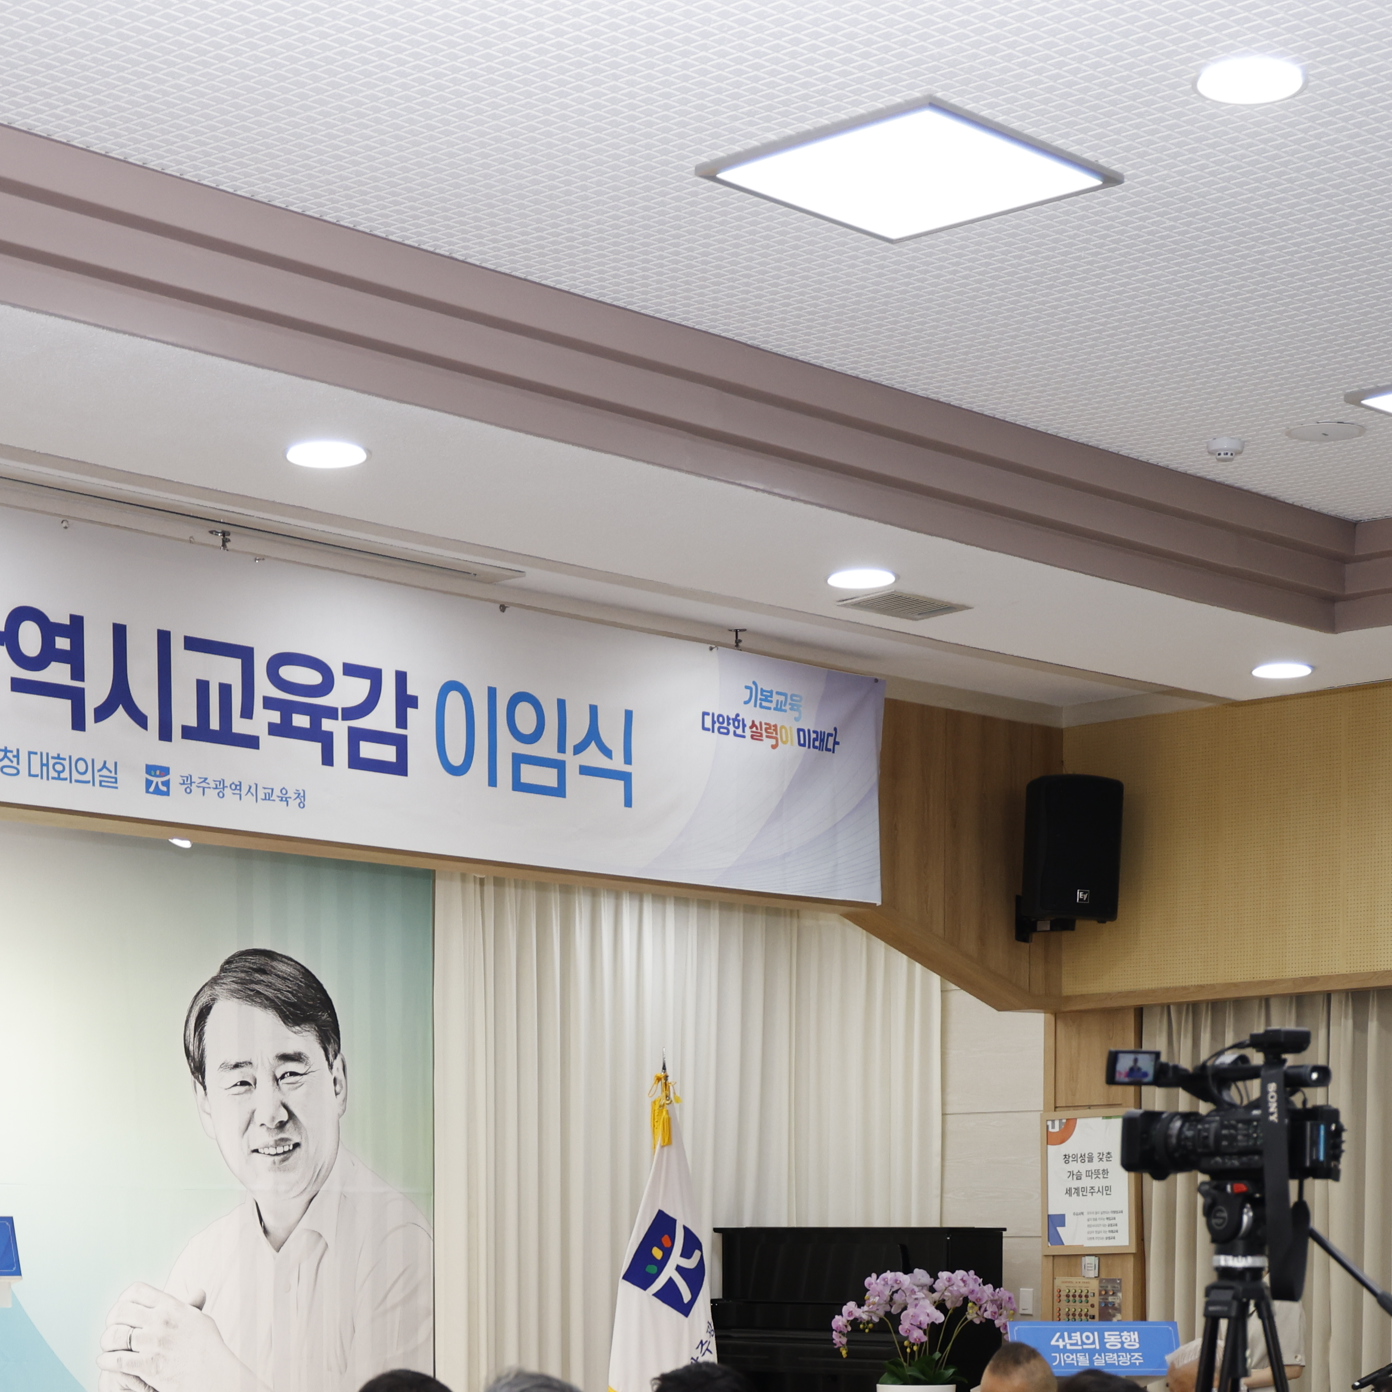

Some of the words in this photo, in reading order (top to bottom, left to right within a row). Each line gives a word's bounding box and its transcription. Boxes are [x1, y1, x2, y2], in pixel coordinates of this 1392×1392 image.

[743, 680, 803, 722] 기본교육
[434, 677, 635, 809] 이임식
[701, 711, 747, 739] 다양한
[749, 720, 794, 750] 실력이
[797, 726, 840, 754] 미래다
[27, 751, 119, 790] 대회의실
[178, 773, 307, 809] 광주광역시교육청
[1267, 1082, 1278, 1123] SONY
[1063, 1152, 1094, 1164] 창의성을
[1097, 1151, 1113, 1163] 갖춘
[1067, 1170, 1083, 1181] 가슴
[1085, 1168, 1109, 1180] 따뜻한
[1064, 1185, 1112, 1197] 세계민주시민
[1050, 1331, 1100, 1349] 4년의
[1104, 1331, 1140, 1349] 동행
[1051, 1353, 1090, 1366] 기억될
[1093, 1352, 1144, 1366] 실력광주
